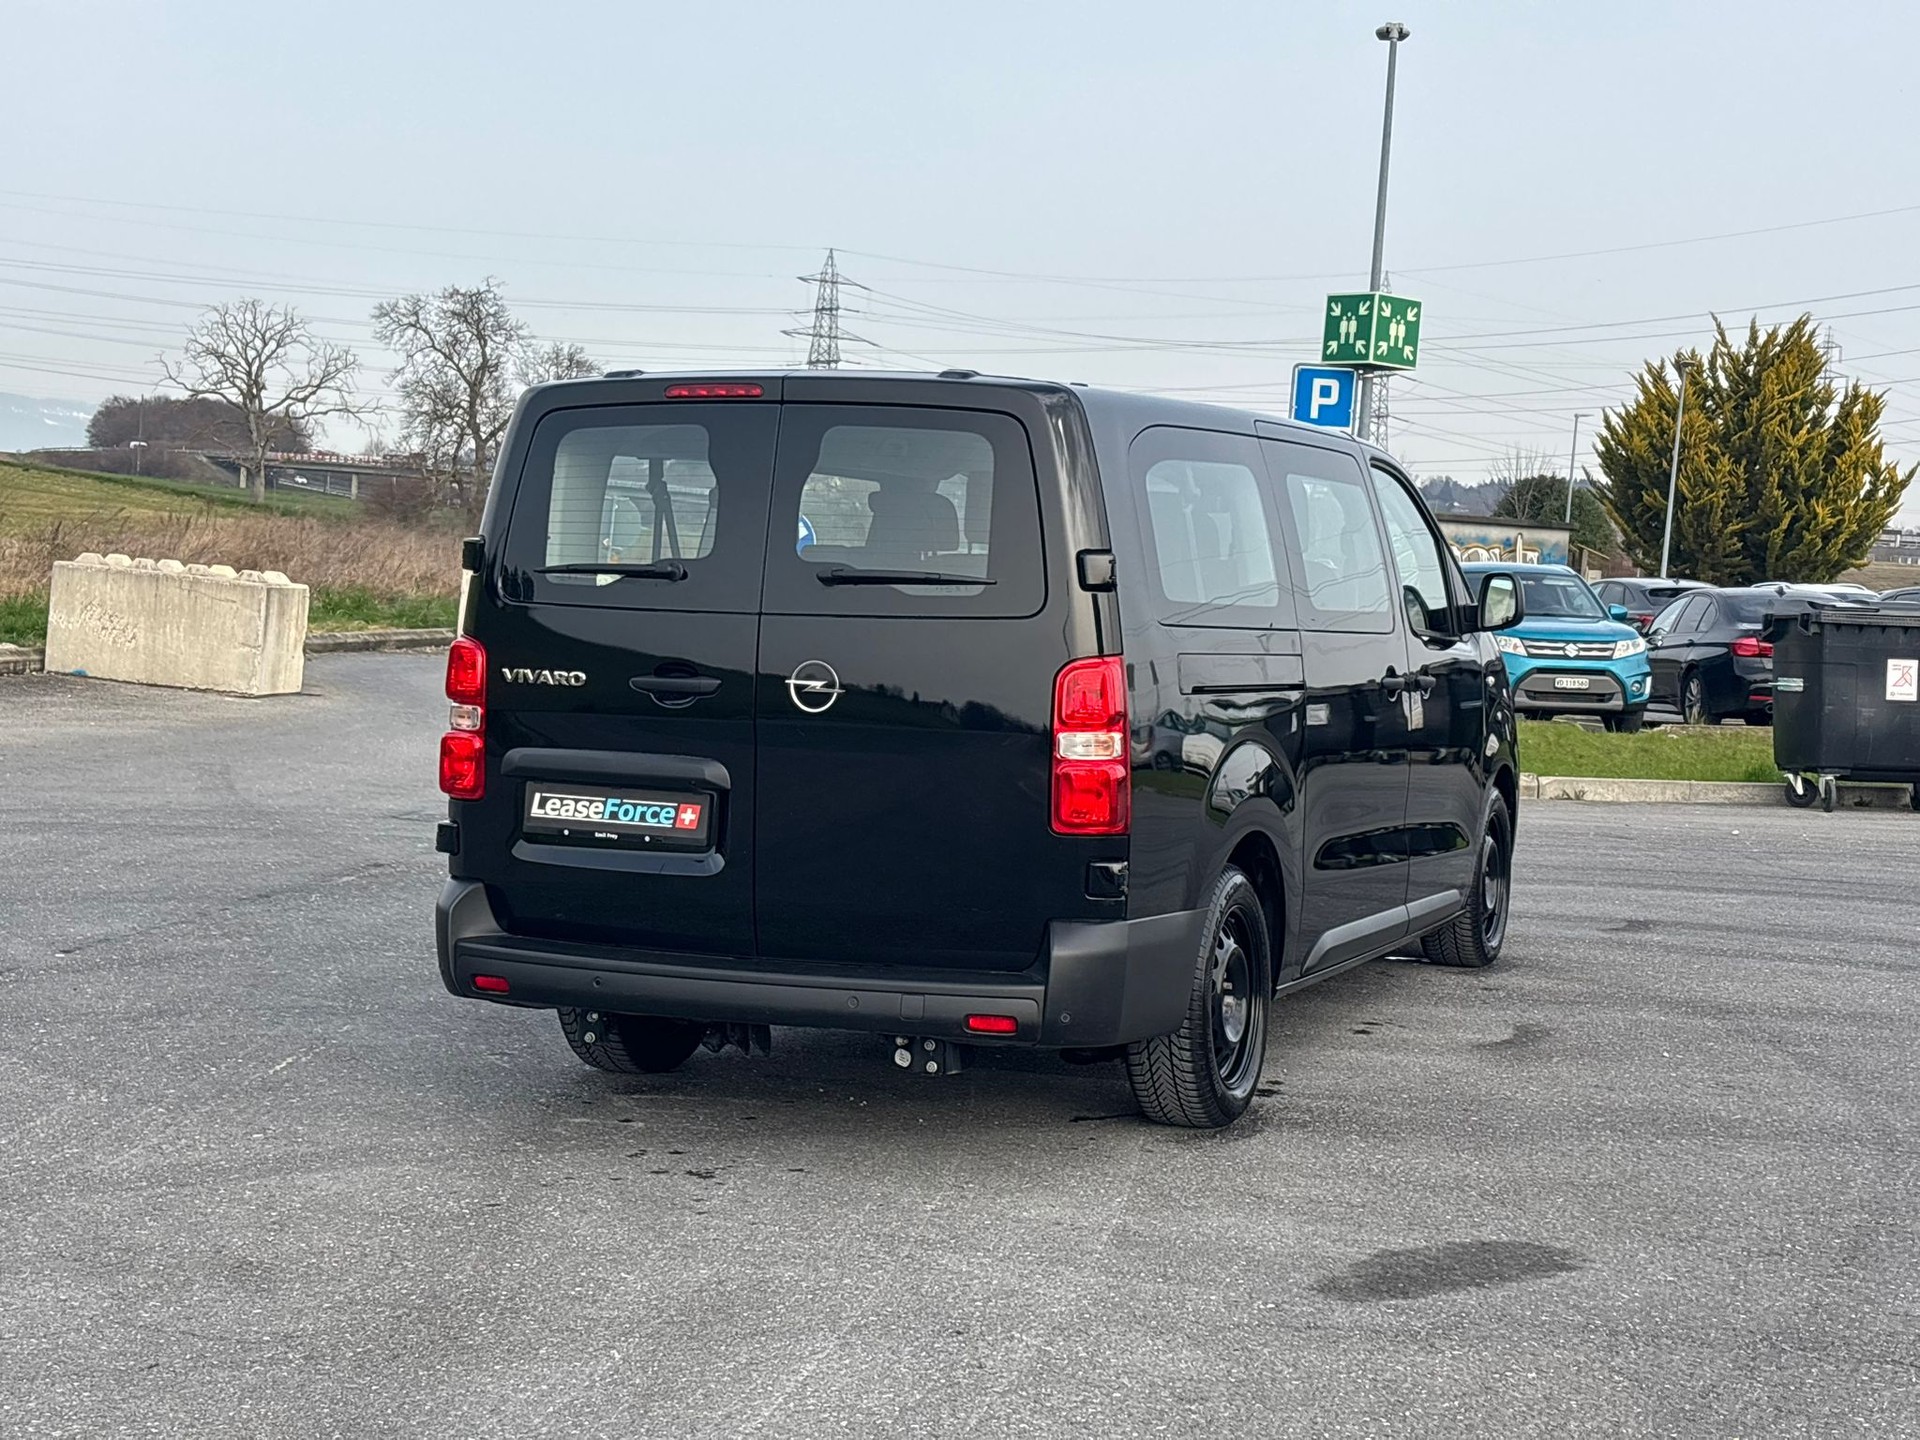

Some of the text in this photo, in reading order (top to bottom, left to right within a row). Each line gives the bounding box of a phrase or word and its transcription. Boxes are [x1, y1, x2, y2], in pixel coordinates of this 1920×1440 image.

[1310, 378, 1340, 419] P
[502, 667, 587, 687] VIVARO
[530, 792, 676, 825] LeaseForce
